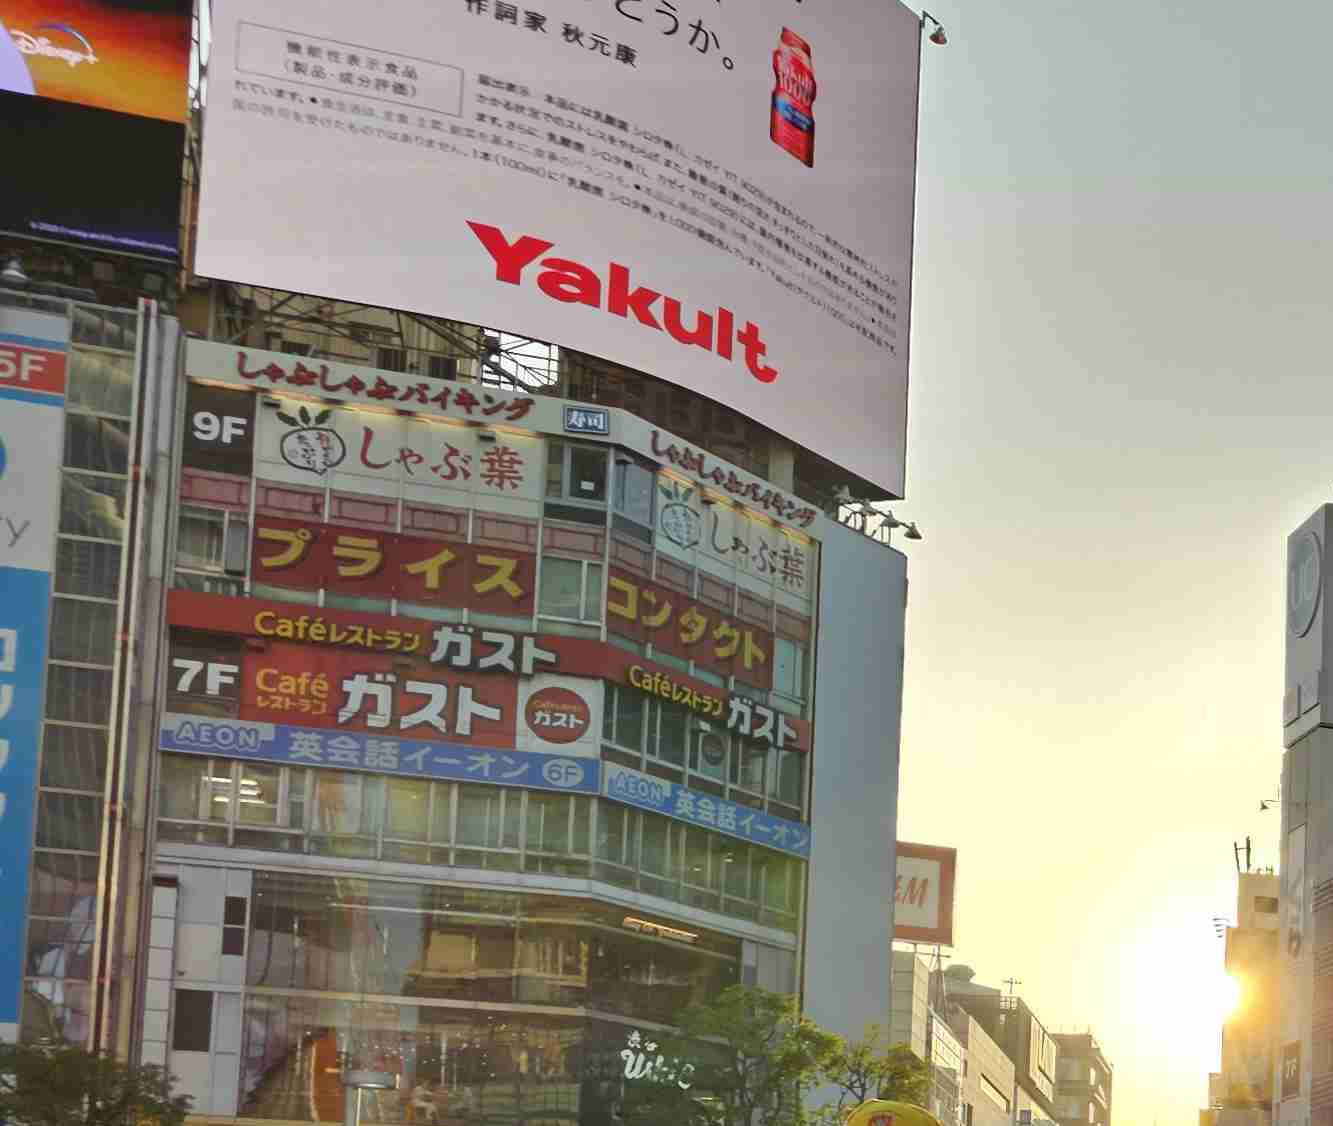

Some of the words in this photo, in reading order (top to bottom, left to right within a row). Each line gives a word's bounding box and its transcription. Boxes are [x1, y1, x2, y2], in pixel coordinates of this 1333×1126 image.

[561, 22, 638, 68] 秋元康
[465, 219, 779, 384] Yakult
[236, 350, 536, 422] しゃぶしゃぶバイキング
[191, 411, 248, 445] 9F
[567, 407, 605, 431] 寿司
[358, 426, 524, 490] しゃぶ葉
[256, 527, 524, 598] プライス
[606, 576, 768, 671] コンタクト
[431, 624, 558, 674] ガスト
[171, 657, 240, 696] 7F
[254, 667, 330, 698] Café
[255, 694, 328, 716] レストラン
[336, 672, 503, 737] ガスト
[532, 710, 585, 730] ガスト
[726, 695, 798, 749] ガスト
[175, 723, 258, 750] AEON
[287, 730, 529, 778] 英会話イーオン
[546, 760, 580, 784] 6F
